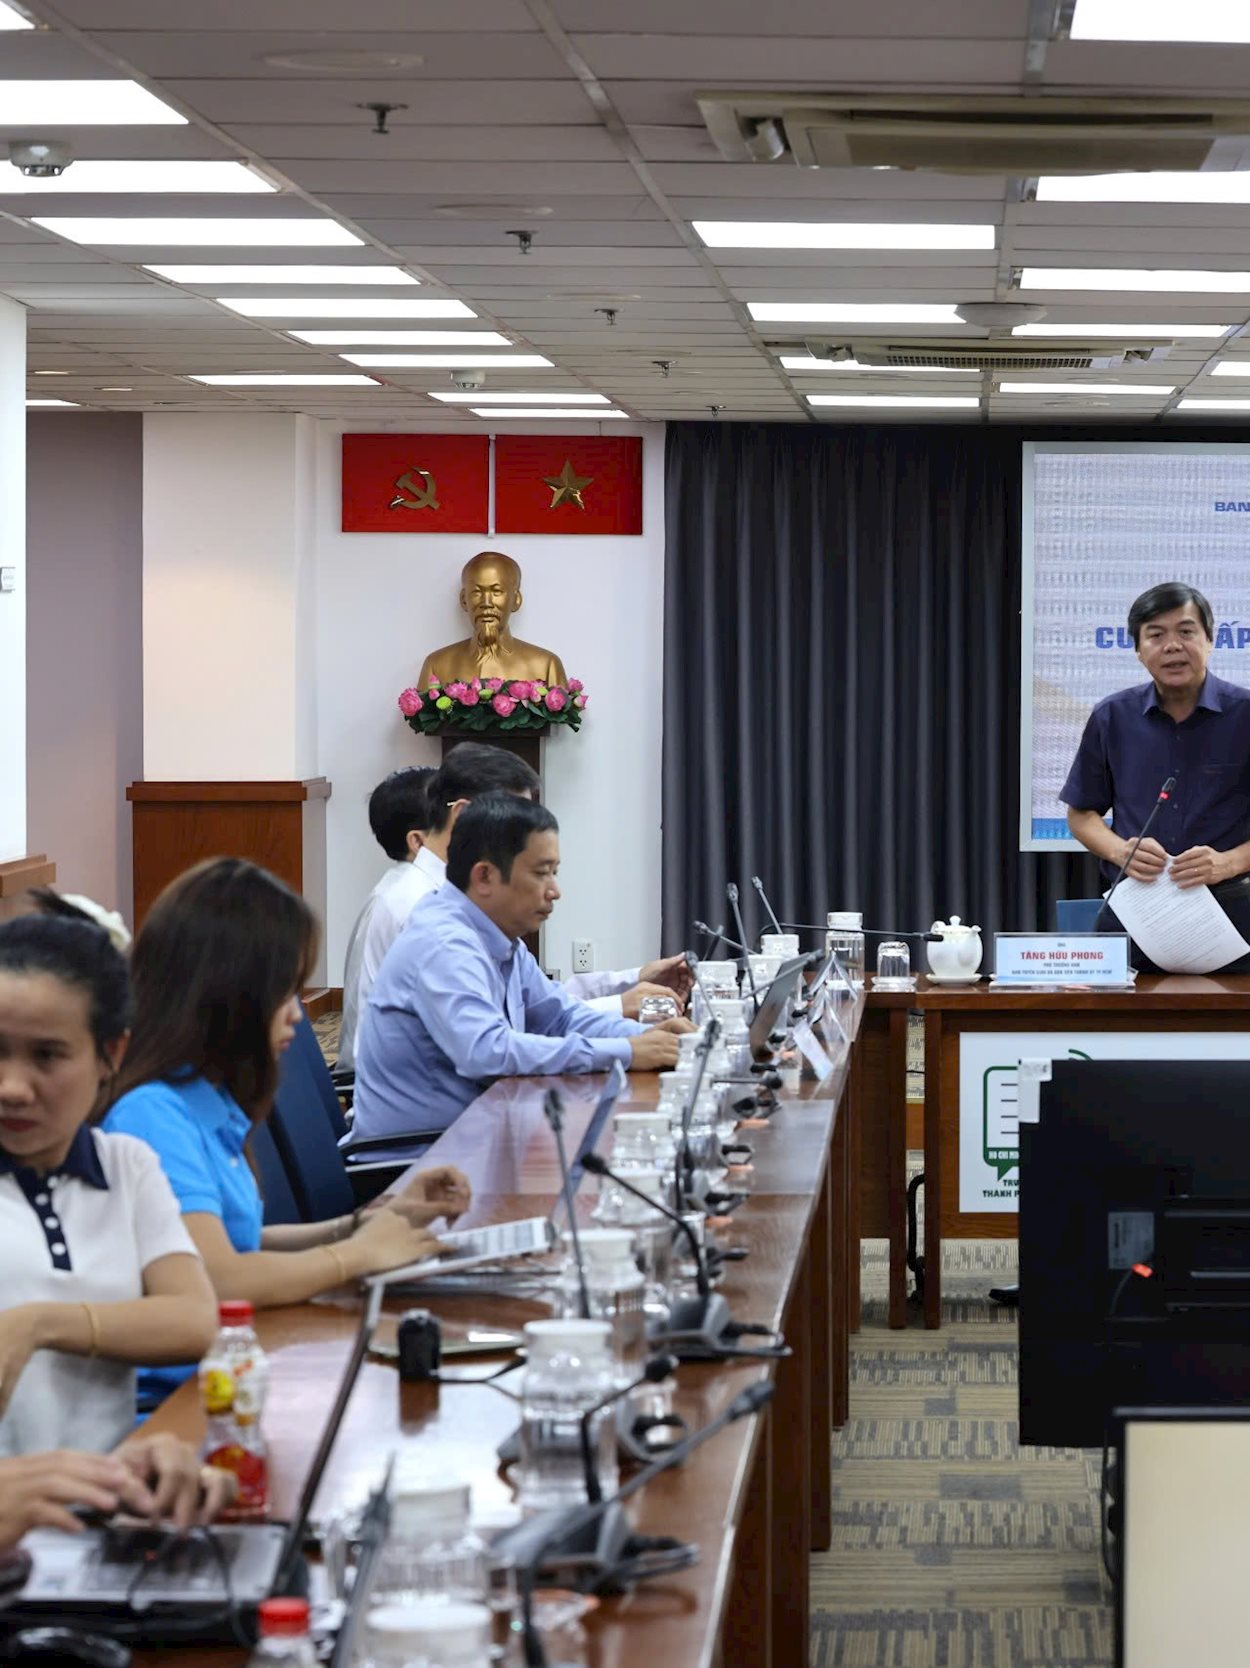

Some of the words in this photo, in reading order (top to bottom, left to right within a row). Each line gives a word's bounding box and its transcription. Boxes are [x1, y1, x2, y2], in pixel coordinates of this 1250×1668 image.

[1215, 500, 1250, 513] BAN
[1095, 626, 1134, 649] CU
[1071, 952, 1104, 960] PHONG
